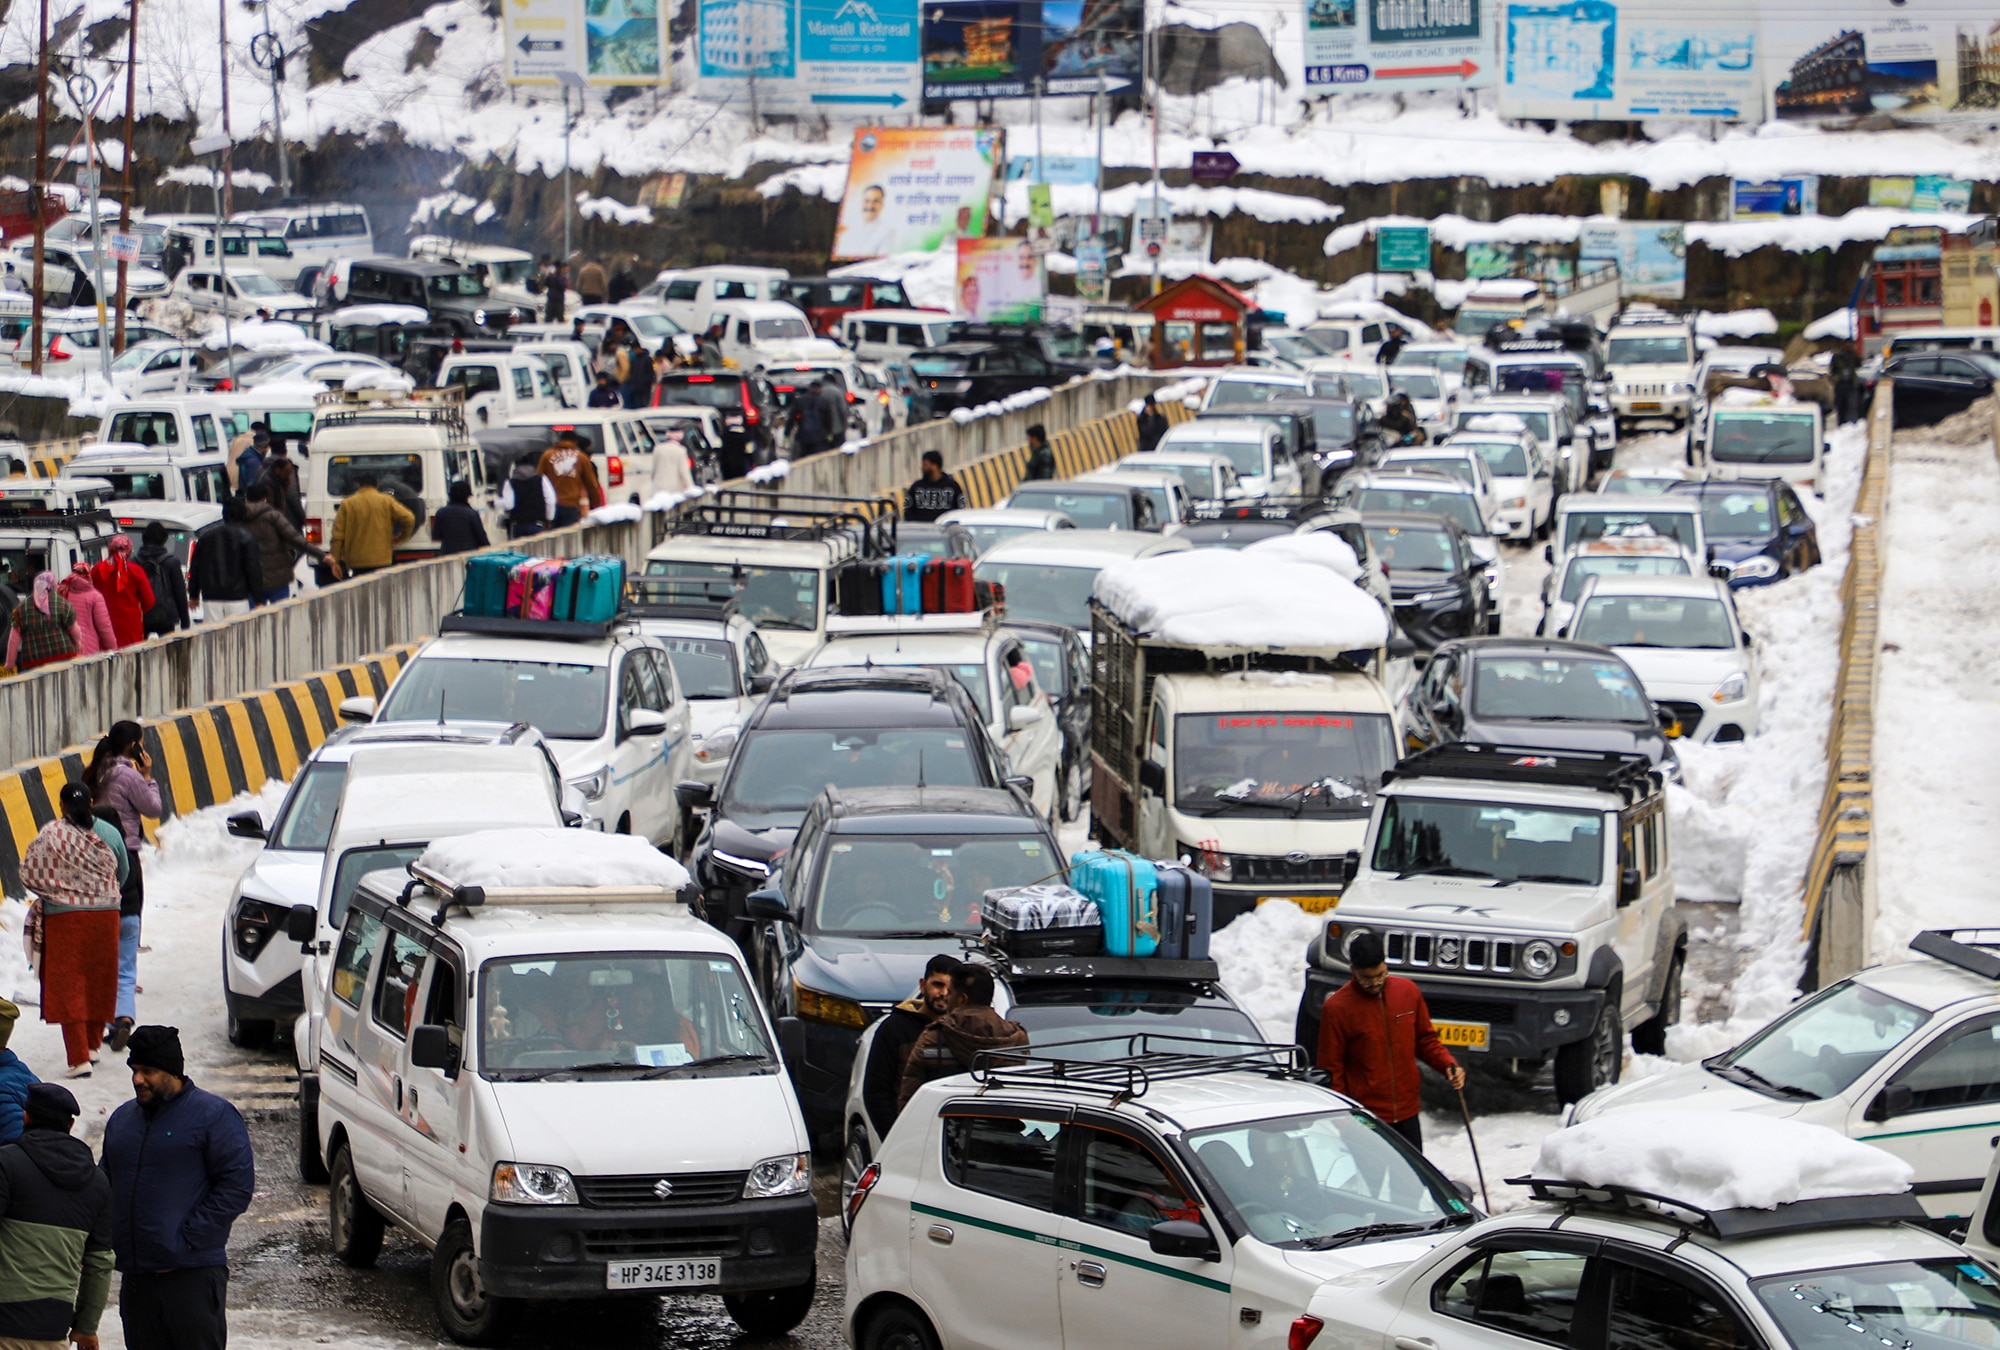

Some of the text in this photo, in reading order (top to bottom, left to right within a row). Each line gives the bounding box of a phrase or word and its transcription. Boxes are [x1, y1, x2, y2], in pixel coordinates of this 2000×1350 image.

[807, 20, 911, 37] Manali Retreat
[711, 526, 724, 534] JAI
